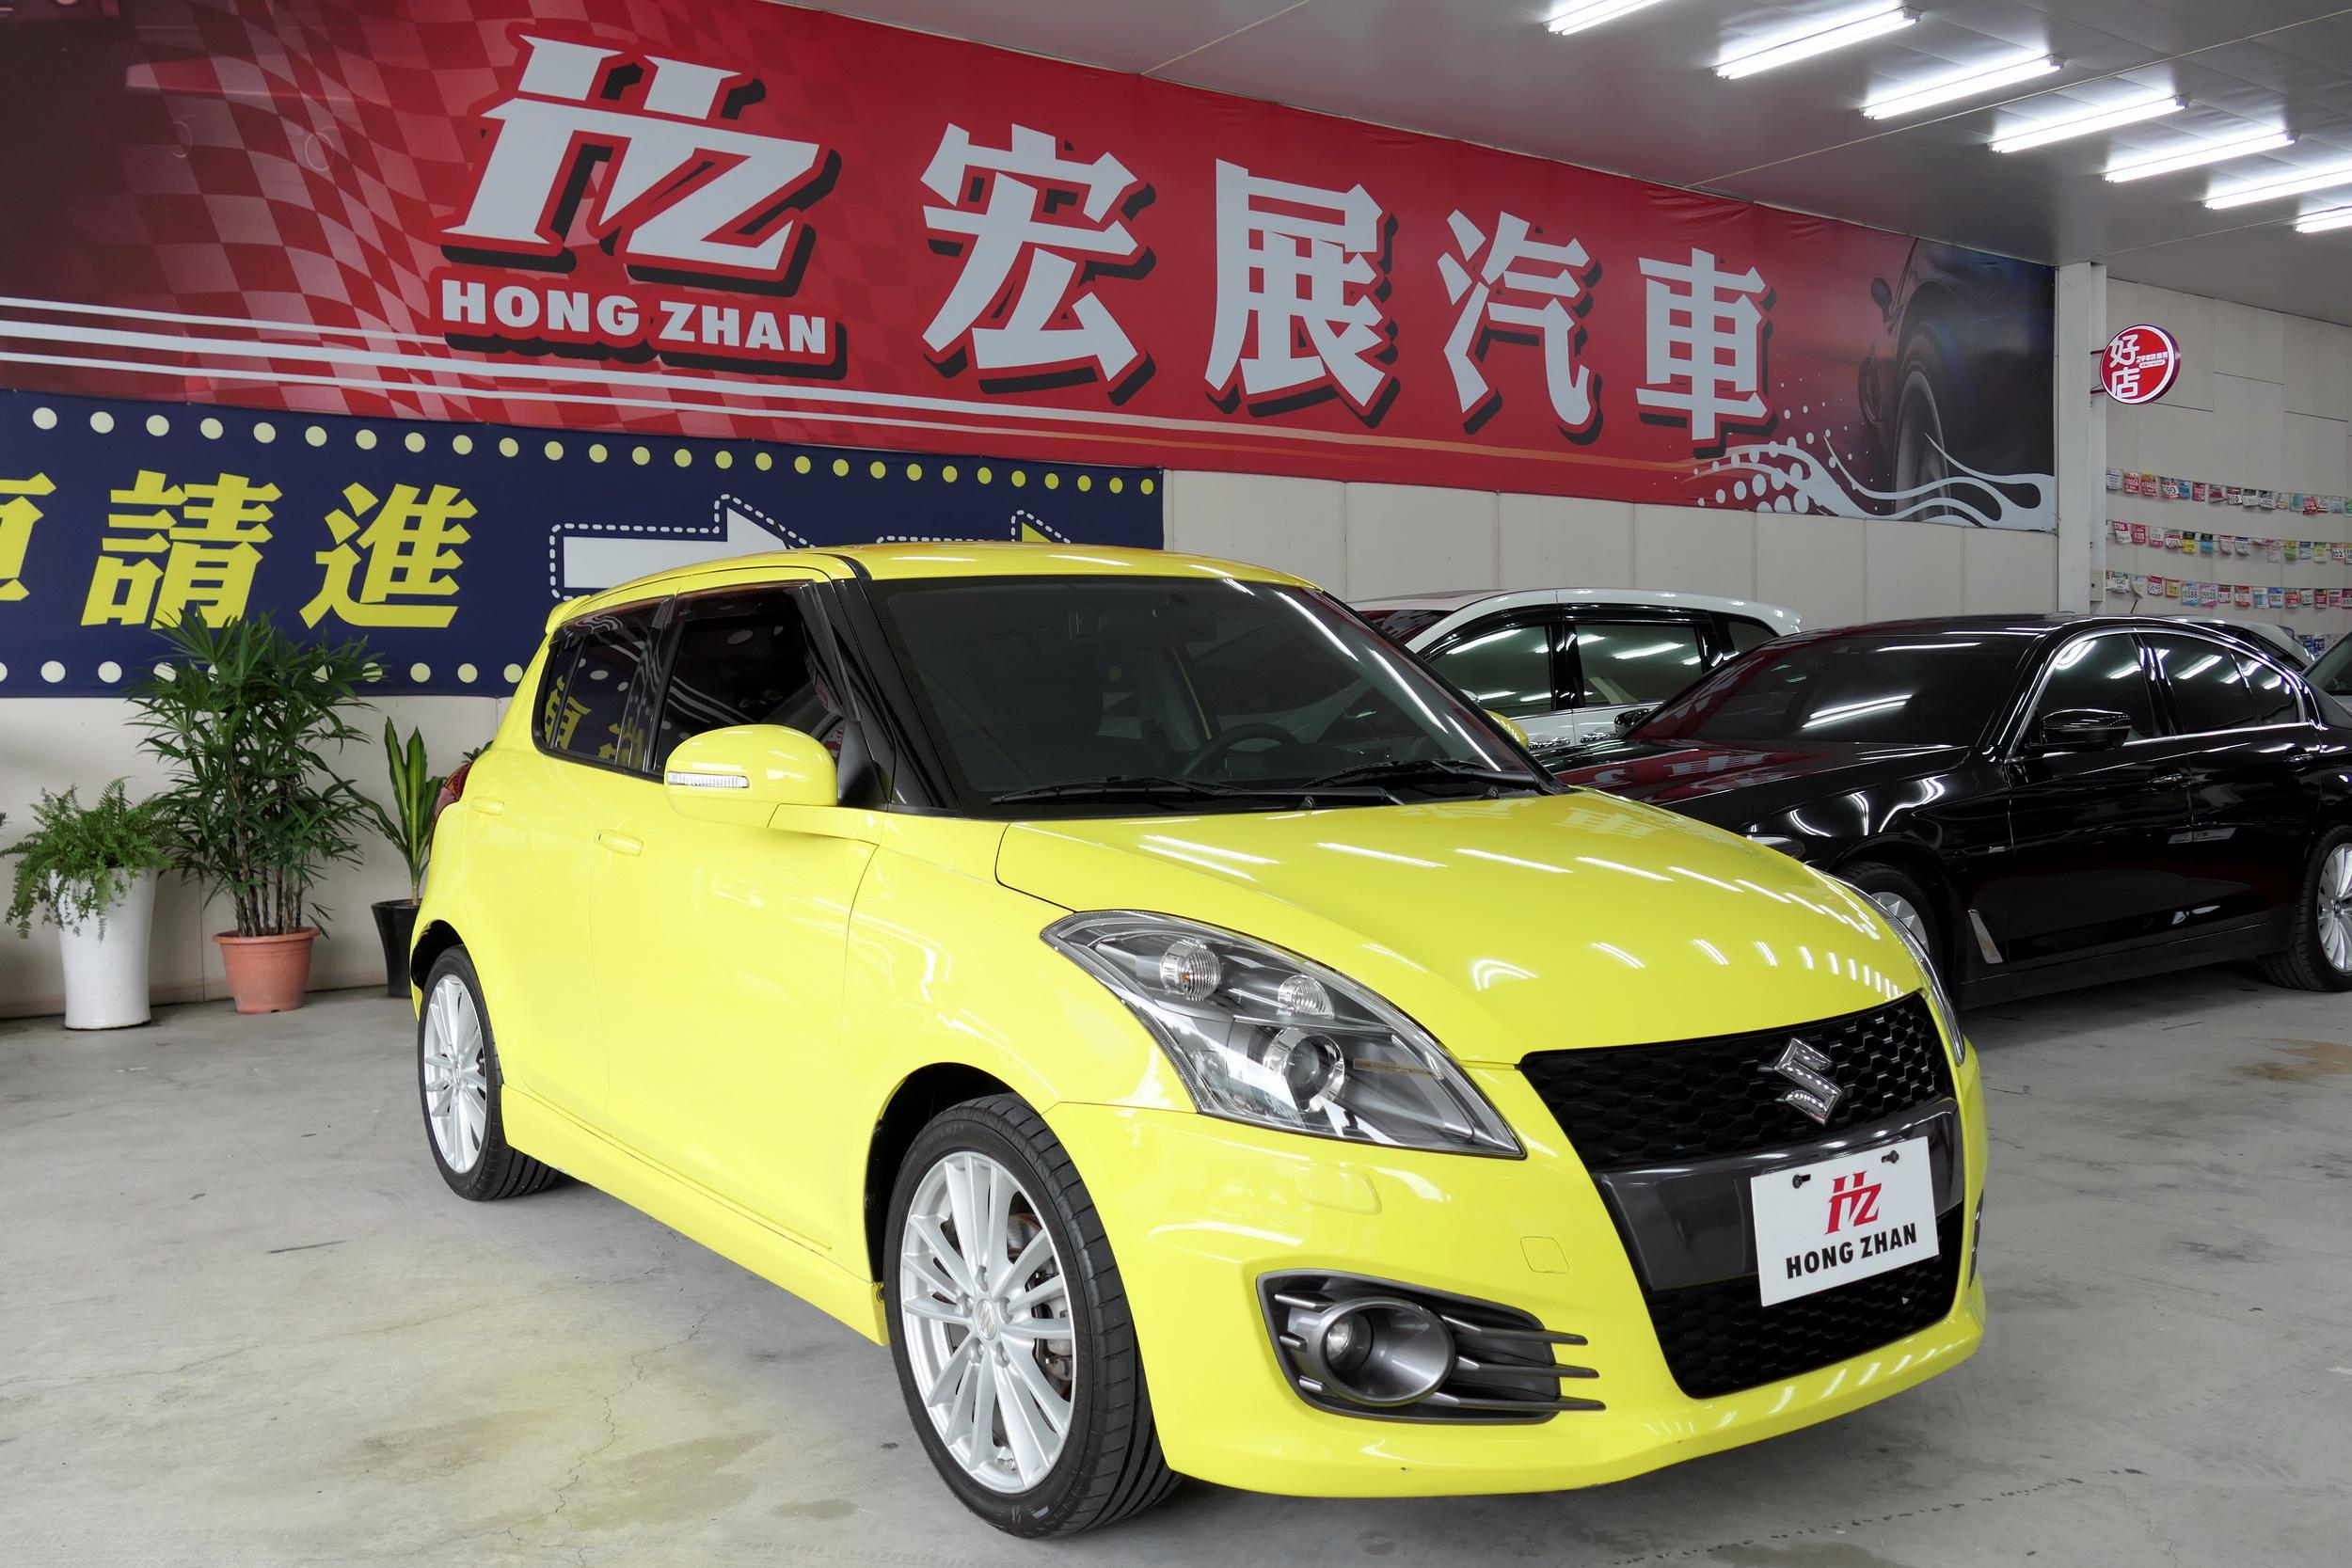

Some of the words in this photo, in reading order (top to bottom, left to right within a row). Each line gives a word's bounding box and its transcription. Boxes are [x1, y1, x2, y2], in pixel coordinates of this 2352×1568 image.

[919, 122, 1768, 440] 宏展汽車
[441, 279, 640, 340] HONG
[660, 300, 828, 355] ZHAN
[2109, 334, 2140, 399] 好店
[1786, 1241, 1854, 1279] HONG
[1859, 1222, 1918, 1259] ZHAN
